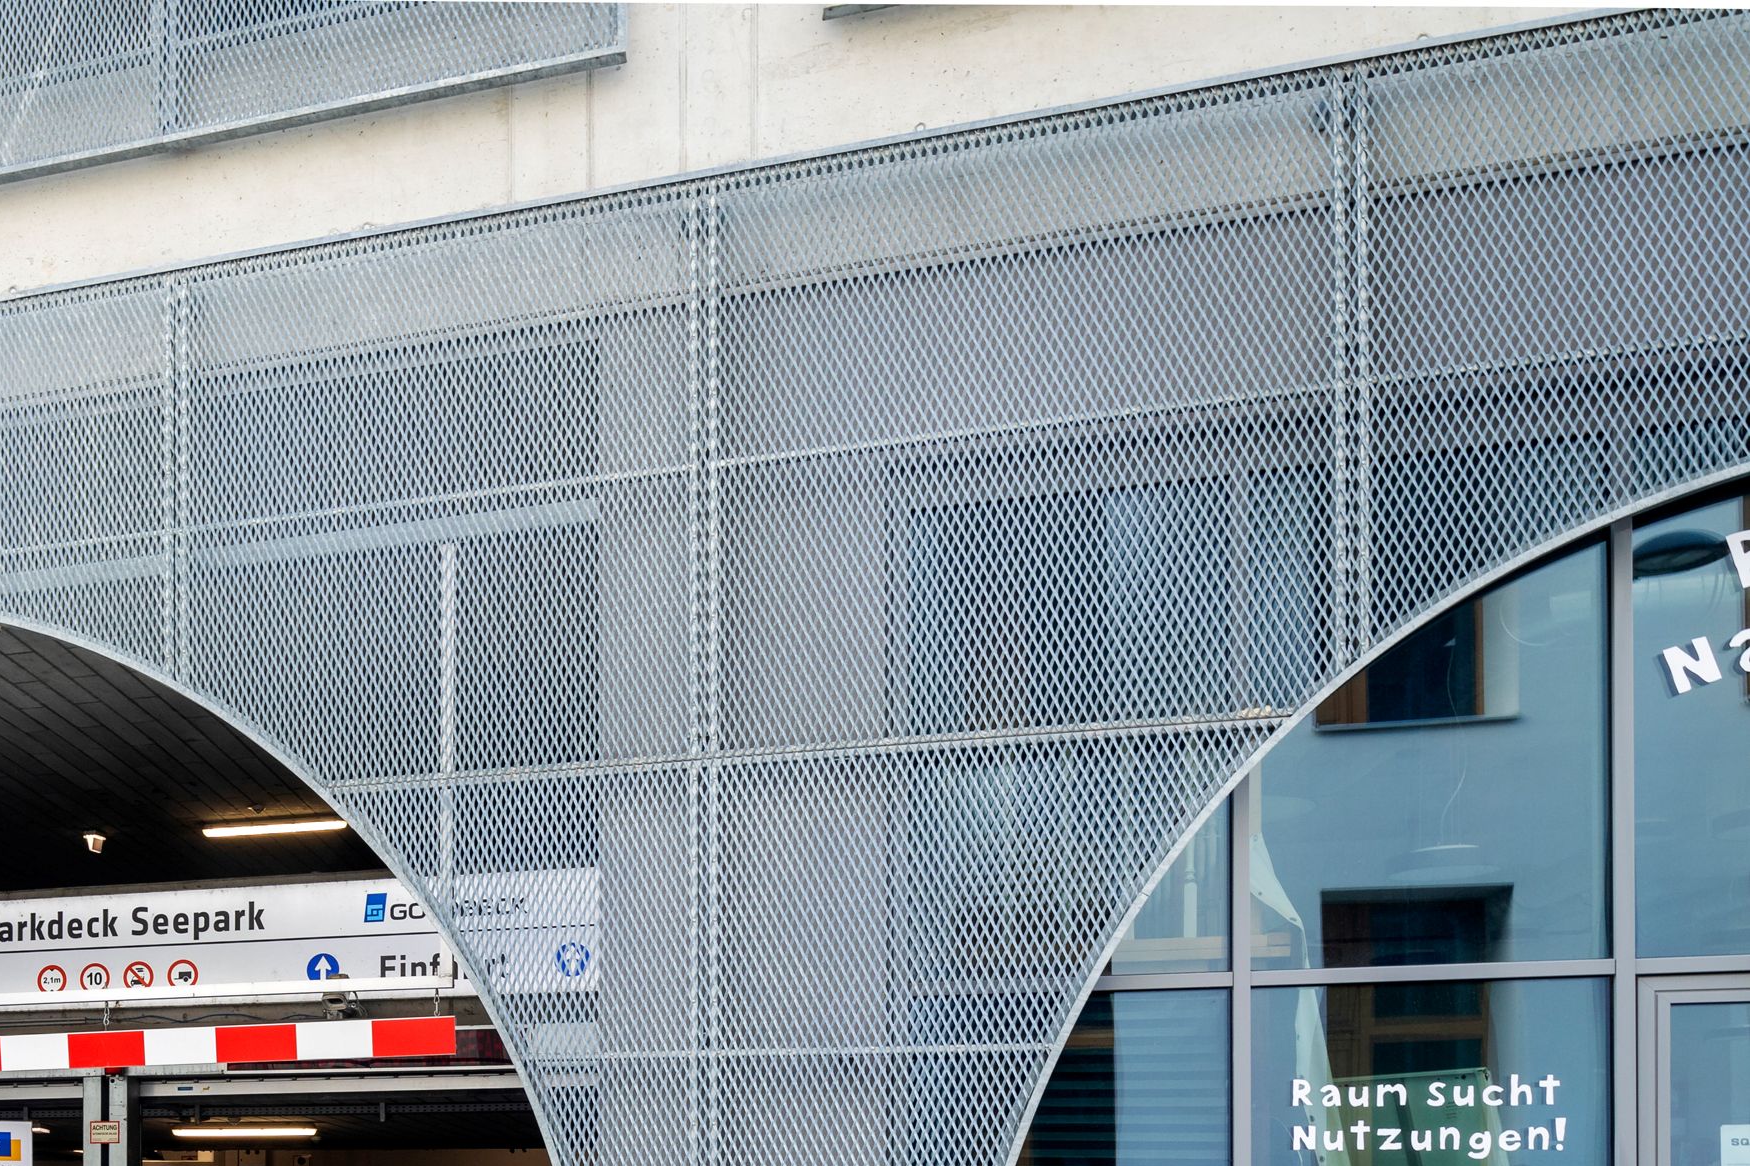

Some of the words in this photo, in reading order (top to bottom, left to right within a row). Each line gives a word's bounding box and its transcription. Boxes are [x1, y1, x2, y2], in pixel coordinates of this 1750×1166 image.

[131, 901, 265, 940] Seepark
[43, 976, 61, 985] 2,1m
[86, 972, 103, 986] 10
[1292, 1078, 1408, 1108] Raum
[1292, 1117, 1567, 1160] Nutzungen!
